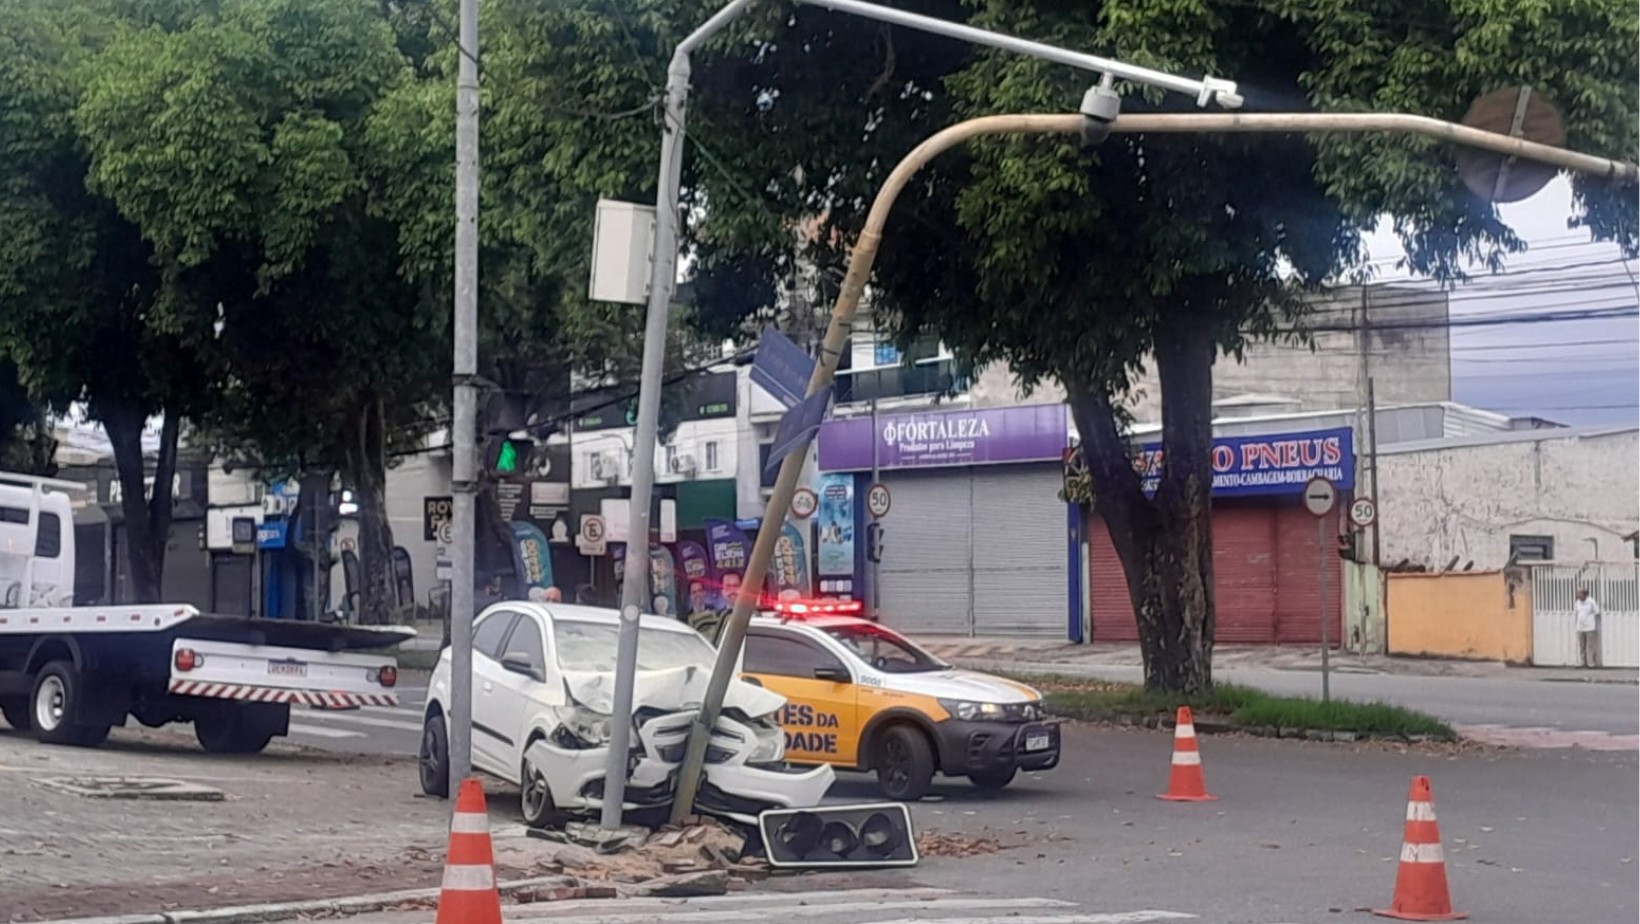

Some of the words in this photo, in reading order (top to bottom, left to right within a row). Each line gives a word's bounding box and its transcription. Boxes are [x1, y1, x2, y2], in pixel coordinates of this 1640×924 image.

[897, 415, 990, 441] FORTALEZA
[1240, 436, 1342, 471] PNEUS
[872, 491, 887, 507] 50
[1355, 504, 1373, 518] 50
[817, 713, 839, 729] DA
